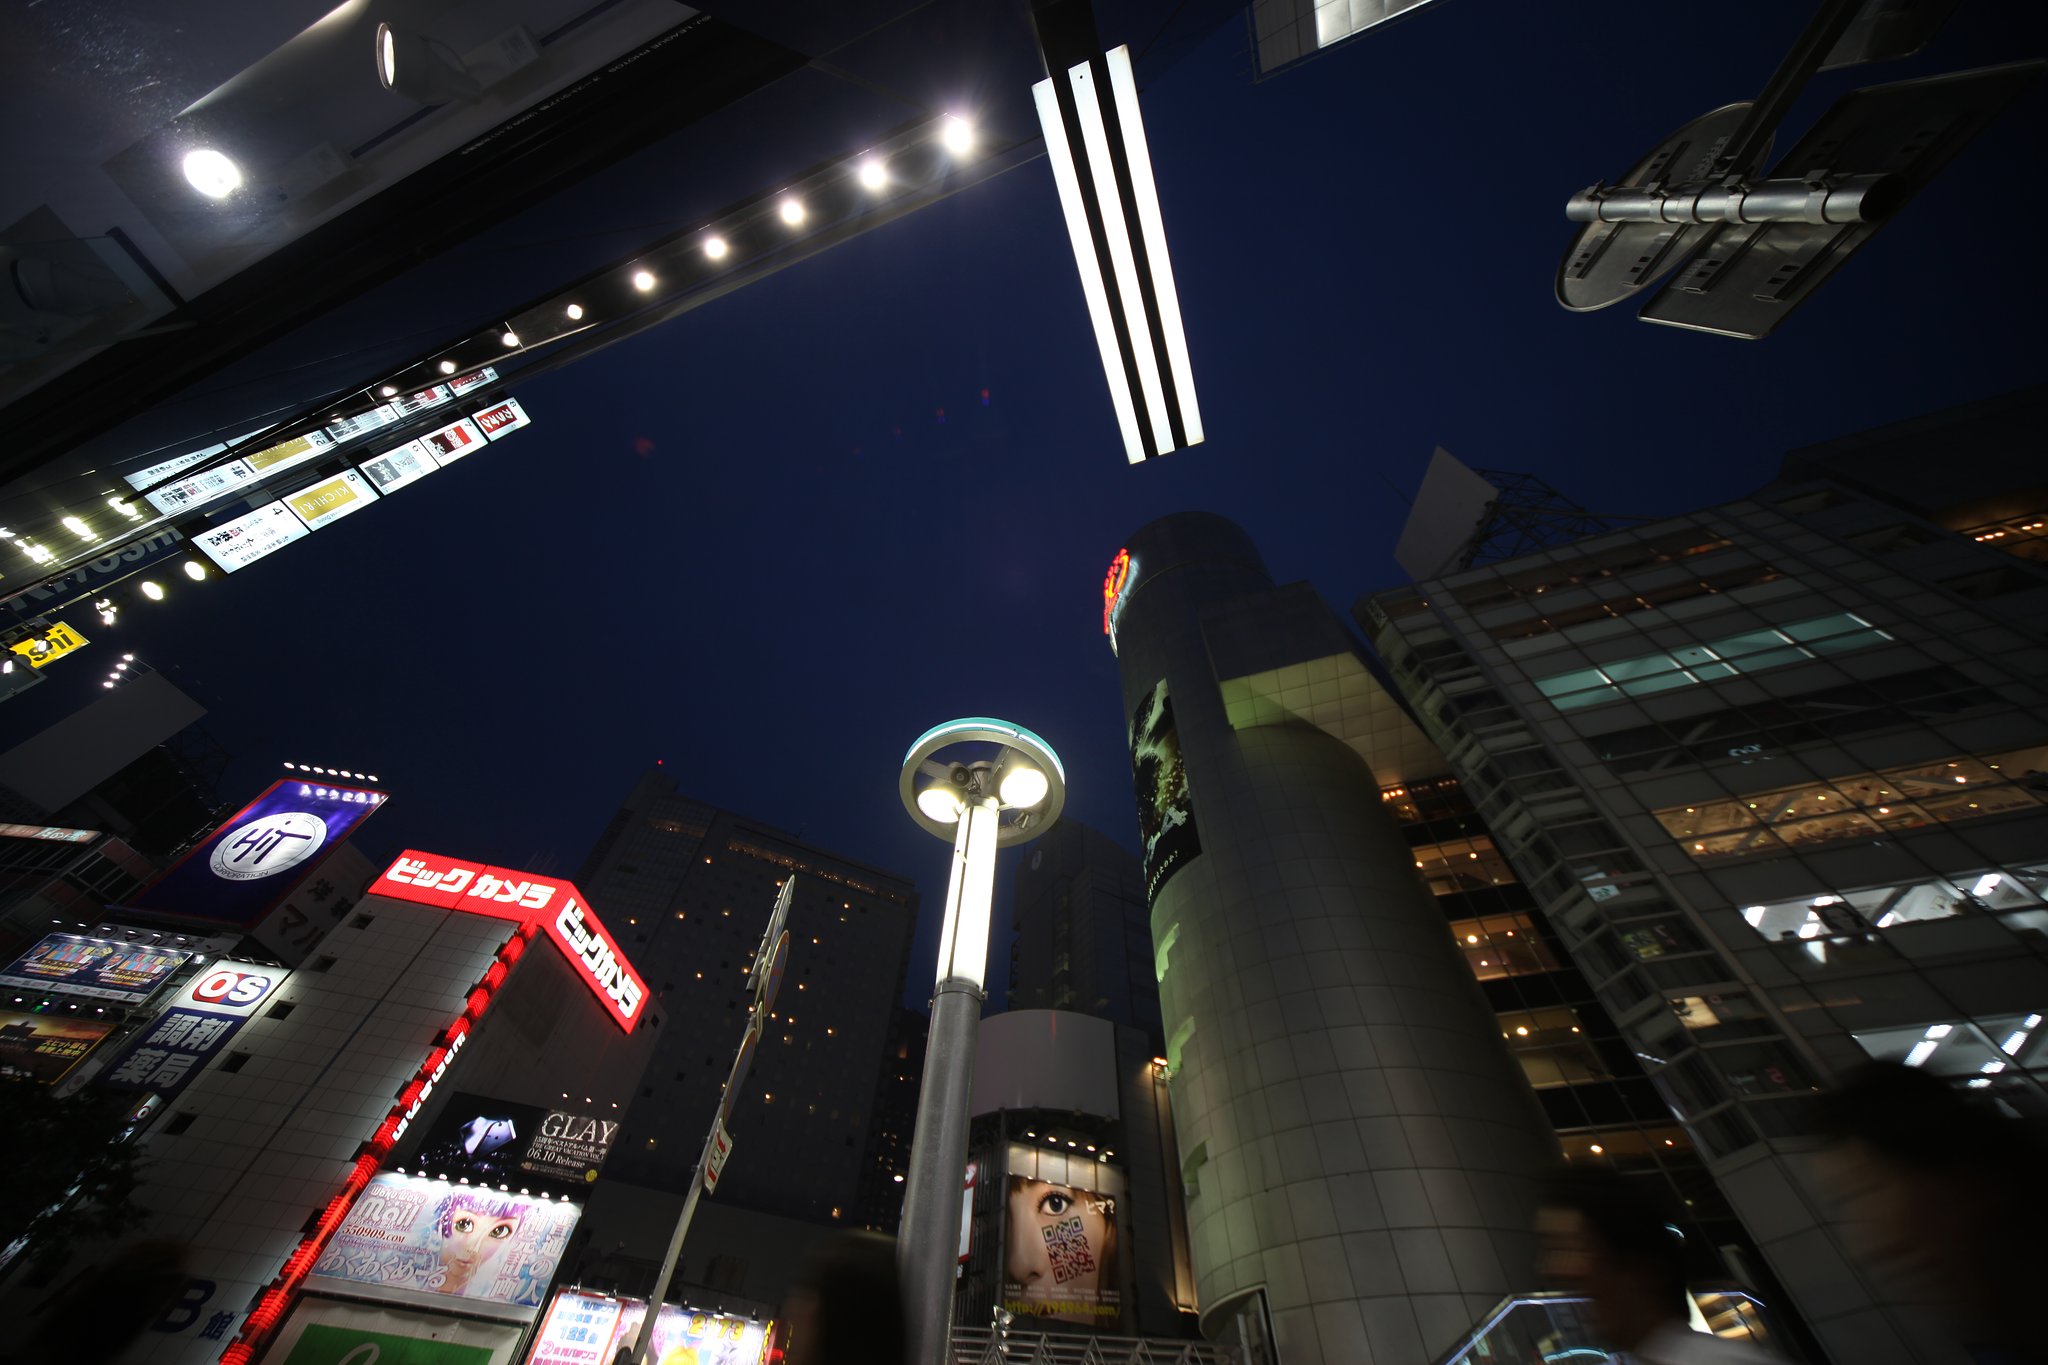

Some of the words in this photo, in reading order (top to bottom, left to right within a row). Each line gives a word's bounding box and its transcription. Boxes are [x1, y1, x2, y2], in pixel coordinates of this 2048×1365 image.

[347, 474, 358, 482] 5
[272, 507, 284, 516] 4
[385, 856, 557, 910] ビックカメラ
[554, 896, 643, 1020] ビックカメラ
[198, 970, 272, 1003] OS
[147, 1012, 234, 1053] 調剤
[110, 1048, 199, 1089] 薬局
[541, 1112, 619, 1145] GLAY
[526, 1147, 556, 1163] 06.10
[555, 1154, 586, 1169] Release
[1084, 1198, 1116, 1216] ヒマ?
[319, 1248, 451, 1290] わくわくめーる
